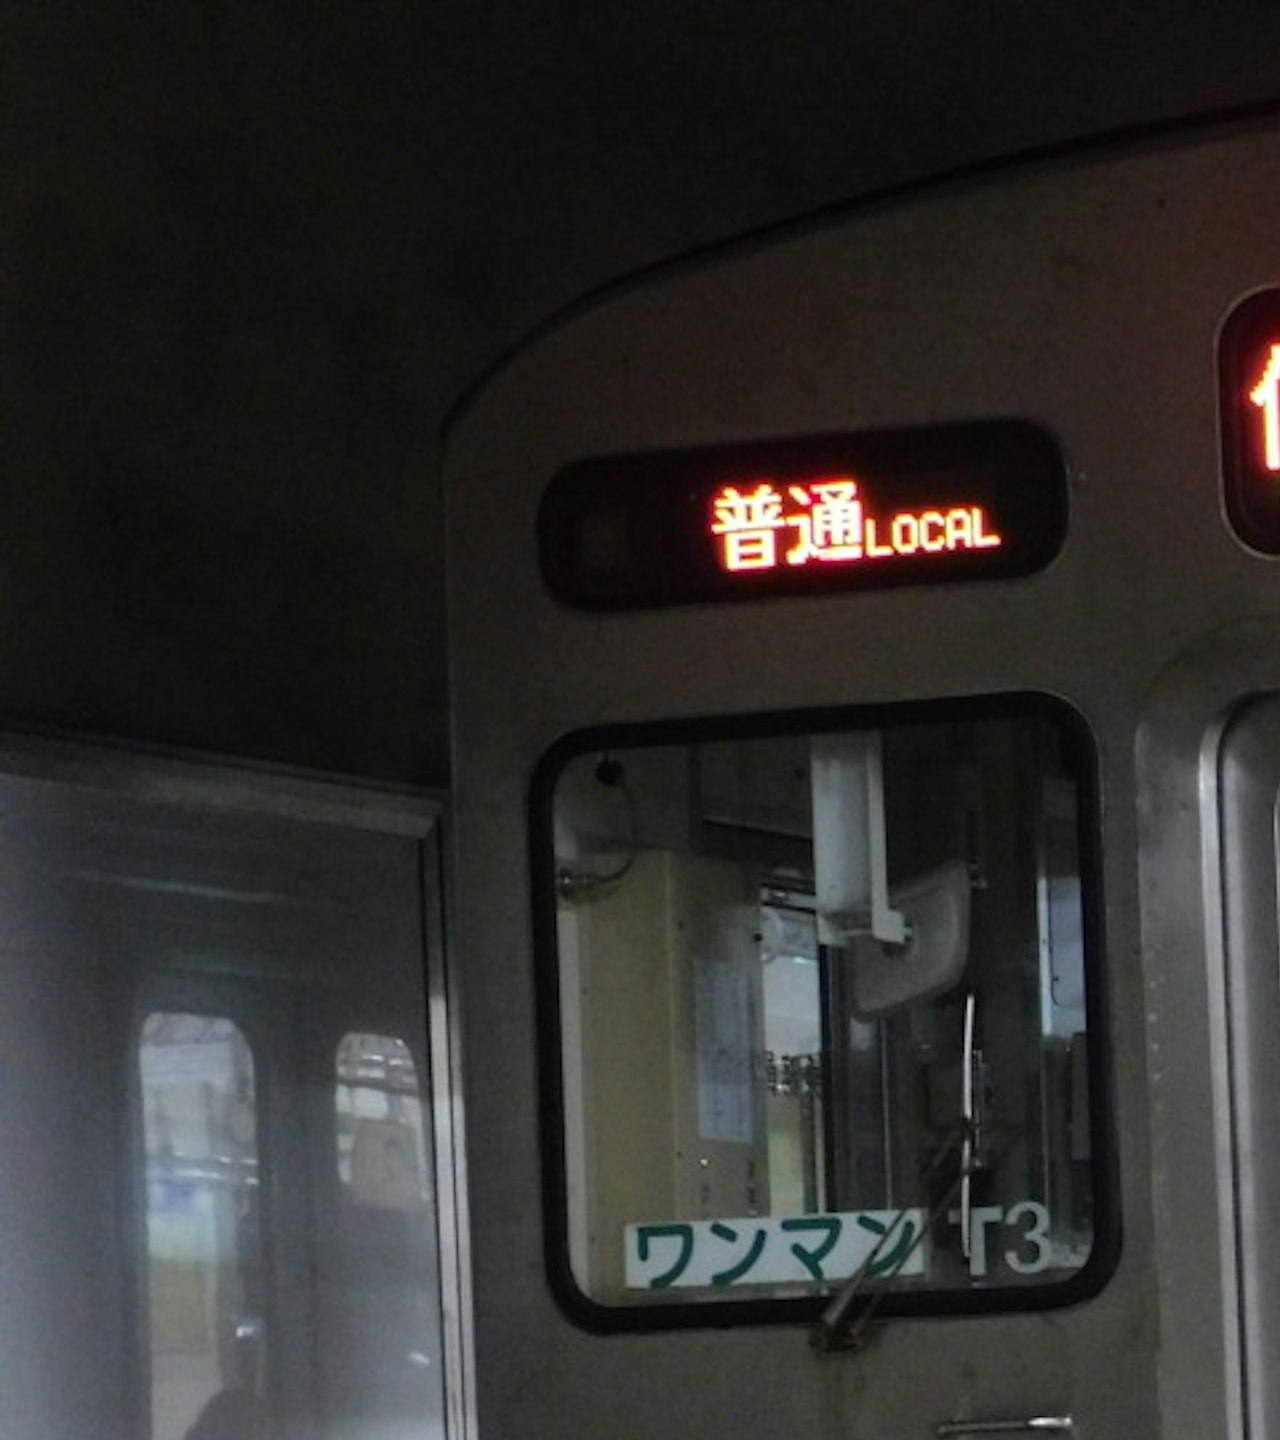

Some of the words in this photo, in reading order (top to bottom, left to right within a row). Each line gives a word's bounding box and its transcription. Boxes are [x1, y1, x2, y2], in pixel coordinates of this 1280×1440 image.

[711, 481, 862, 571] 普通
[864, 507, 1001, 557] LOCAL
[637, 1214, 915, 1288] ワンマン
[948, 1201, 1051, 1276] T3
